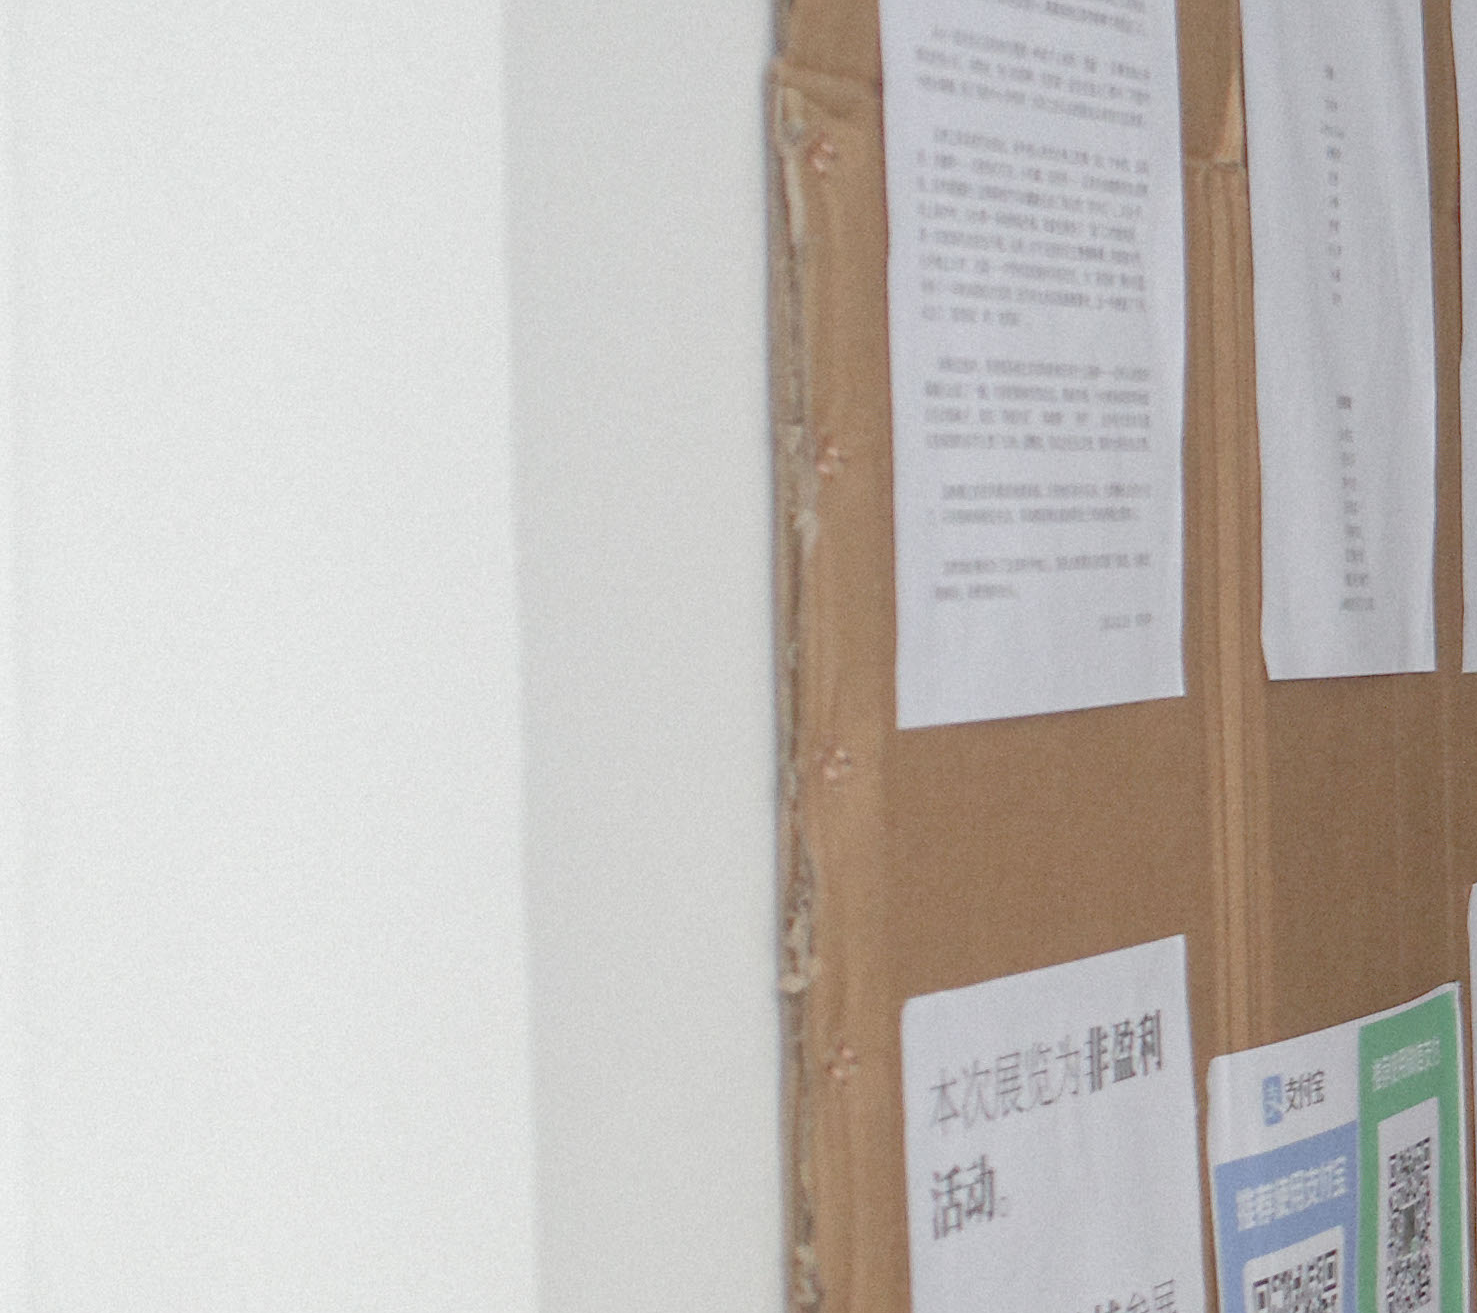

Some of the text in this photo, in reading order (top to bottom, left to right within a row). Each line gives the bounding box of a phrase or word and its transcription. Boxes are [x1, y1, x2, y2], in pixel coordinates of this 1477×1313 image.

[930, 1009, 1164, 1132] 本次展览为非盈利
